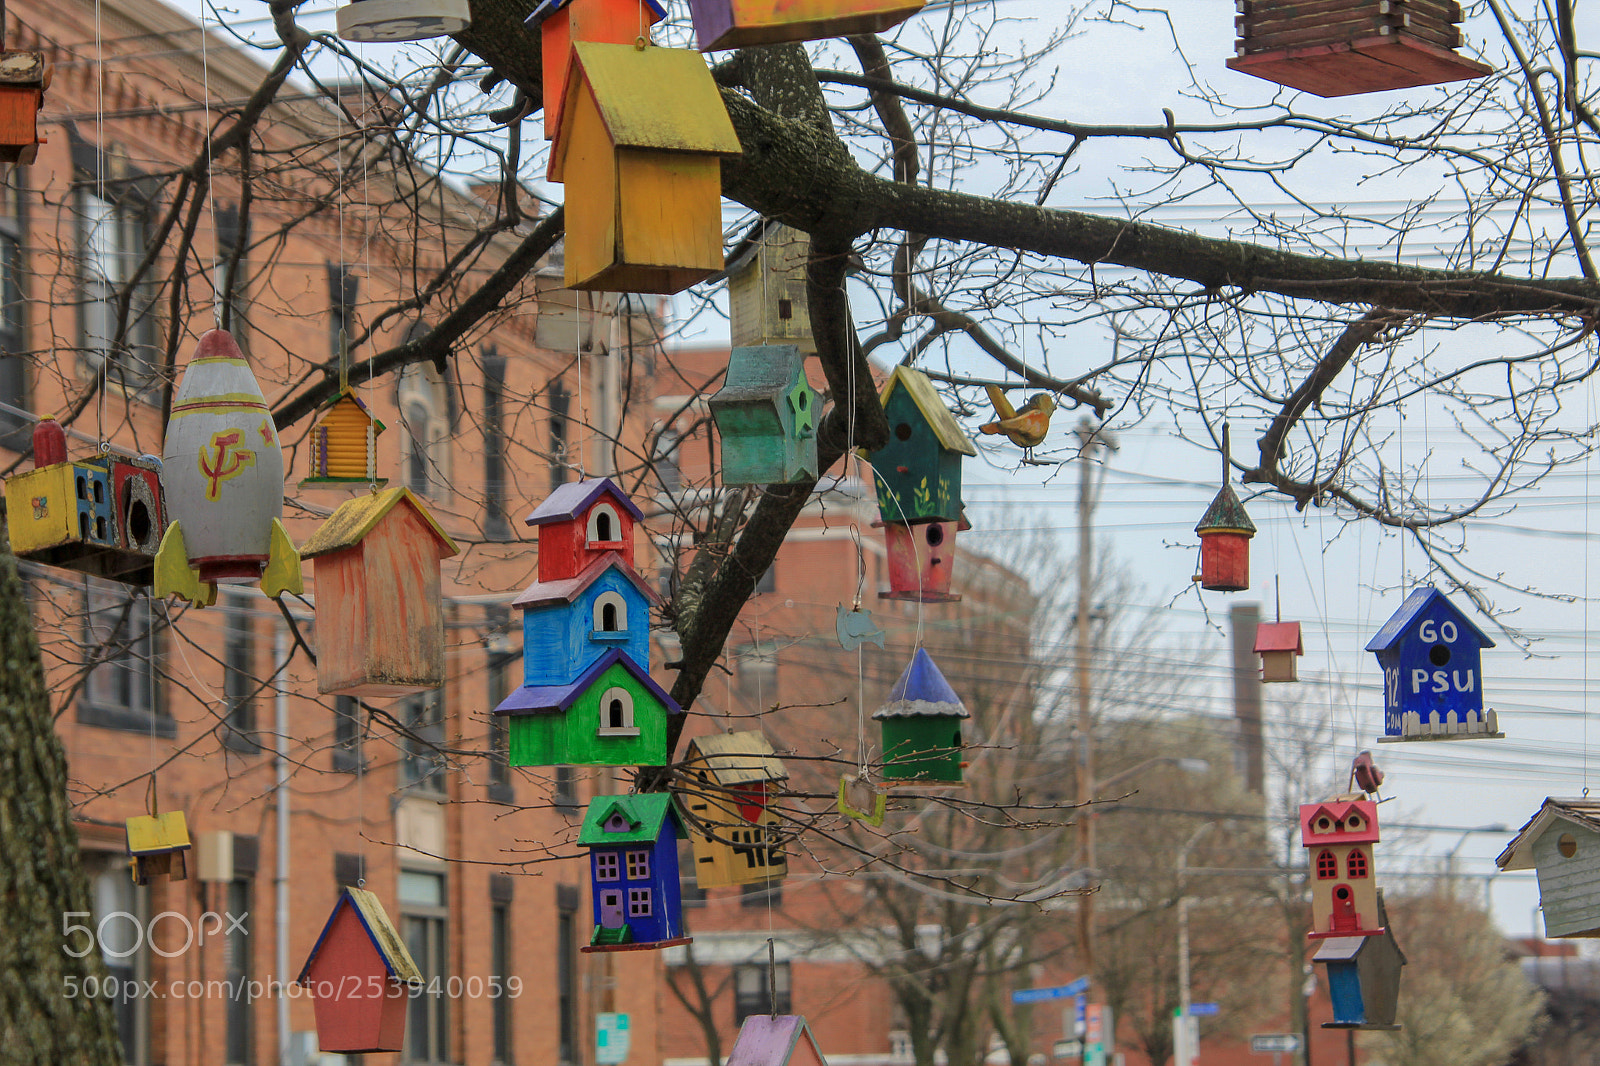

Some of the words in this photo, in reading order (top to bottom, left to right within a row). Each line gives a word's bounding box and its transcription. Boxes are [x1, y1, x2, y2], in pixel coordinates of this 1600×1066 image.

[1419, 619, 1458, 643] GO
[1411, 668, 1475, 694] PSU
[732, 821, 785, 868] 412
